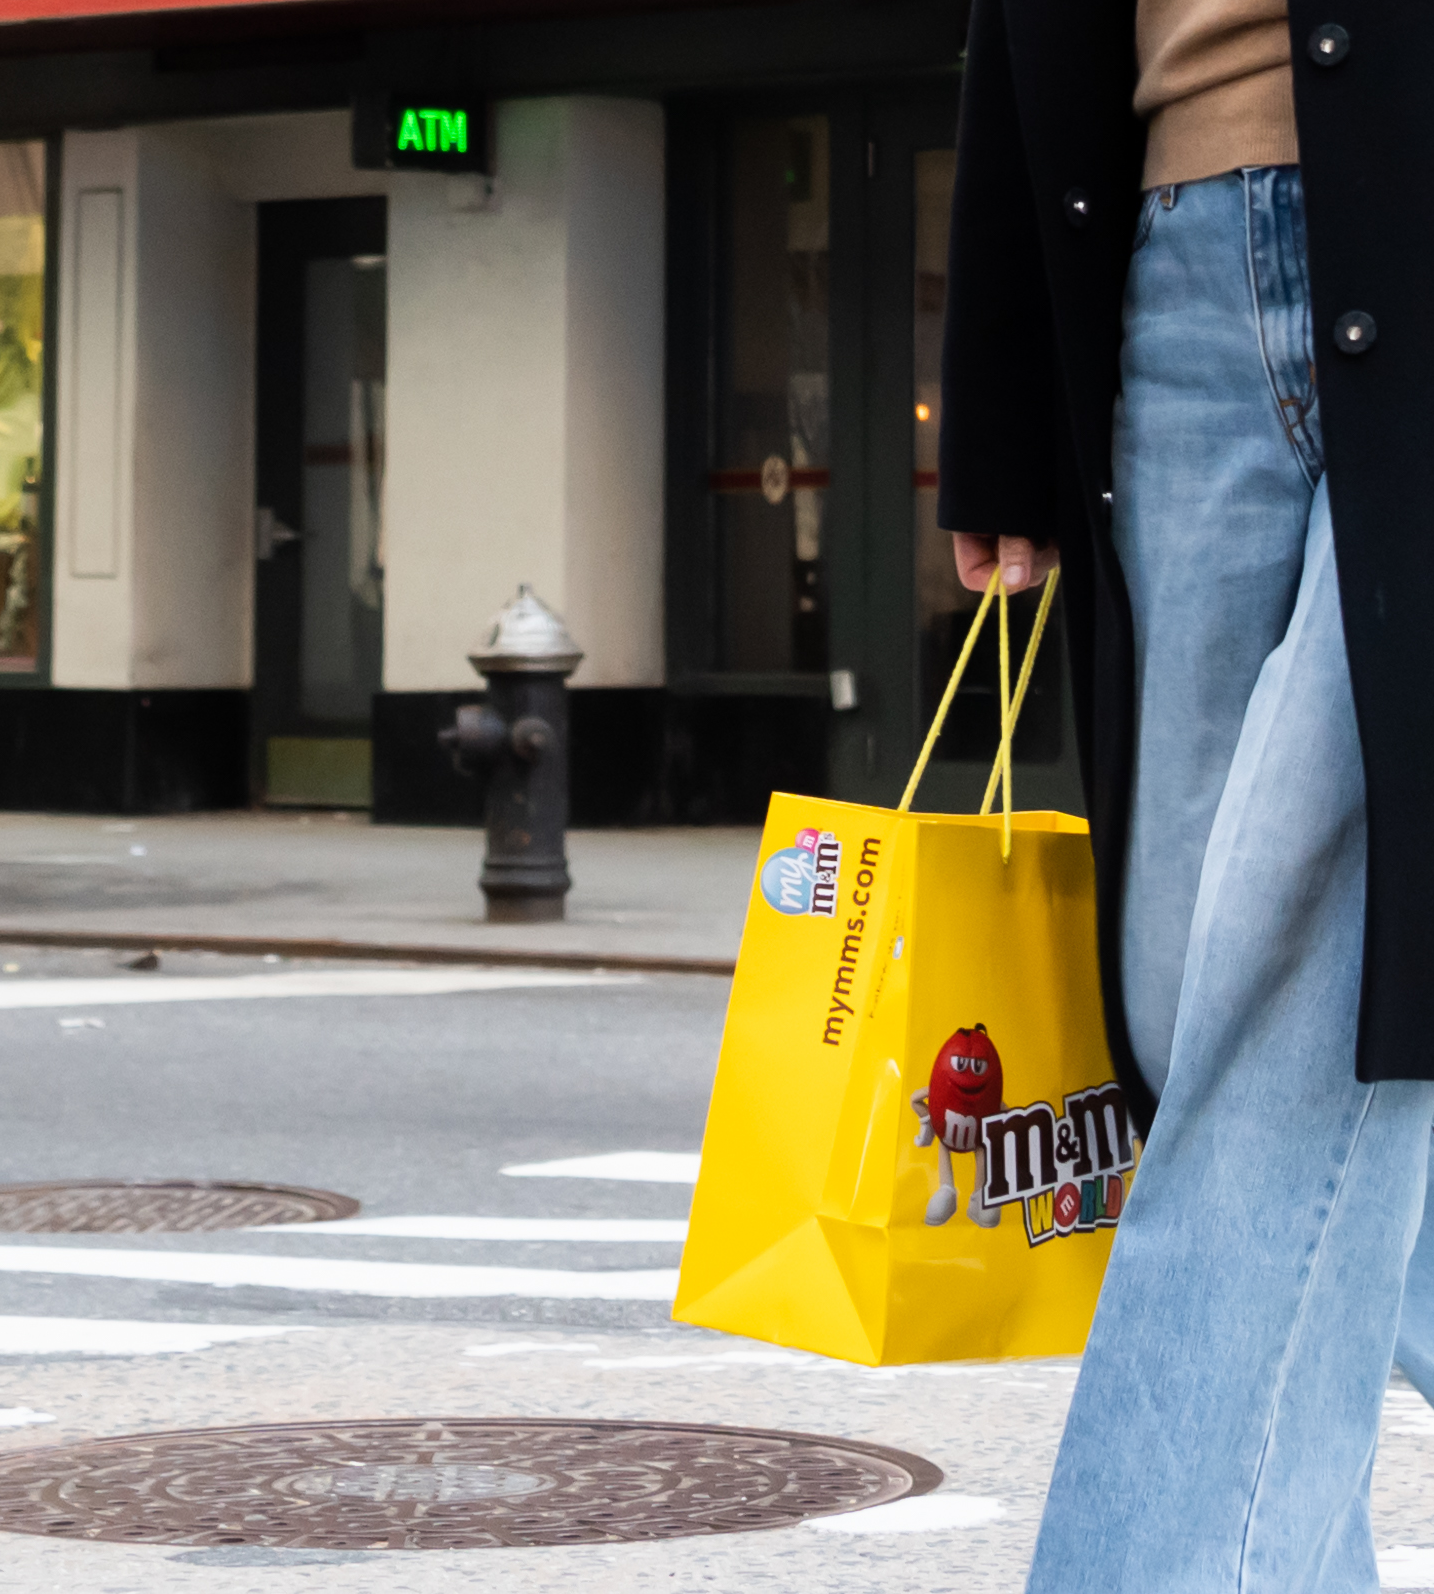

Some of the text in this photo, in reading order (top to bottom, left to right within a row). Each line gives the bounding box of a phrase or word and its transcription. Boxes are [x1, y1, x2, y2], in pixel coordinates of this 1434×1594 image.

[397, 109, 467, 153] ATM
[779, 850, 816, 910] my
[821, 836, 883, 1047] mymms.com
